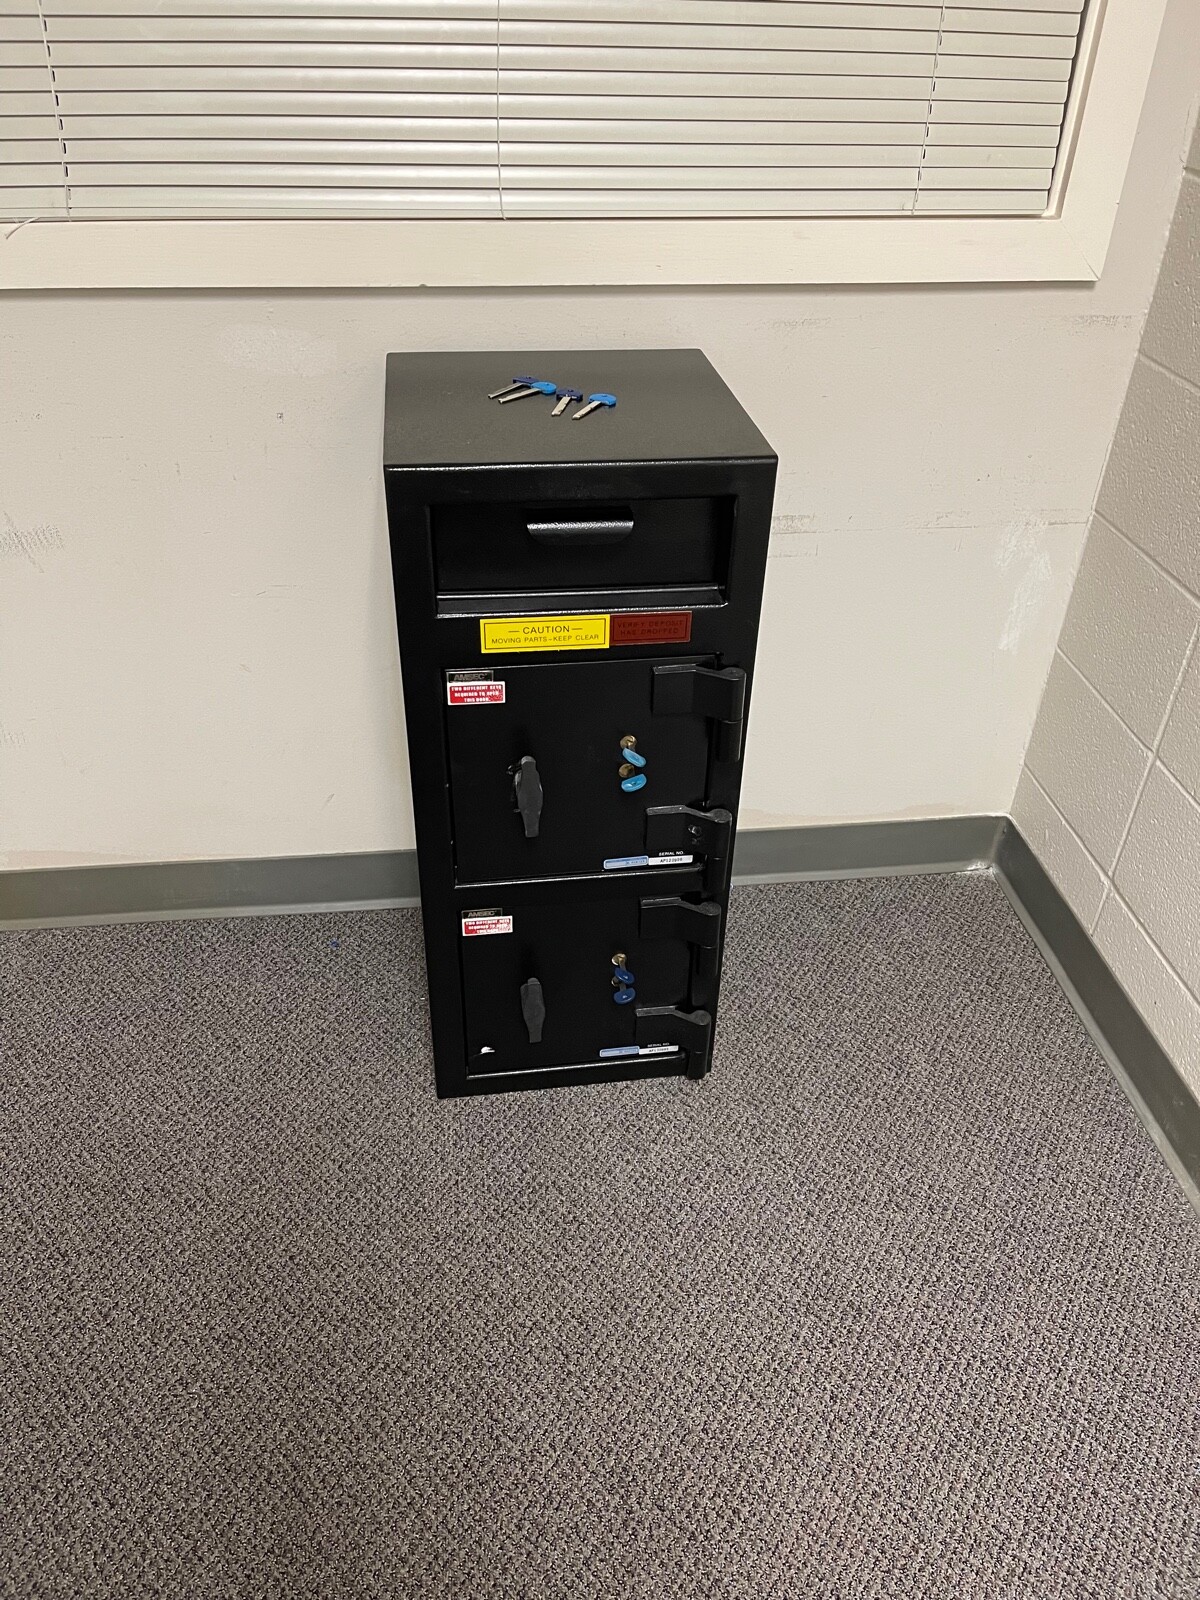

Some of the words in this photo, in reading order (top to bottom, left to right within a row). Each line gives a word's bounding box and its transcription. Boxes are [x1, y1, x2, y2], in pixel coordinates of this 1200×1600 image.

[522, 625, 570, 635] CAUTION
[491, 637, 522, 645] MOVING
[575, 633, 600, 641] CLEAR
